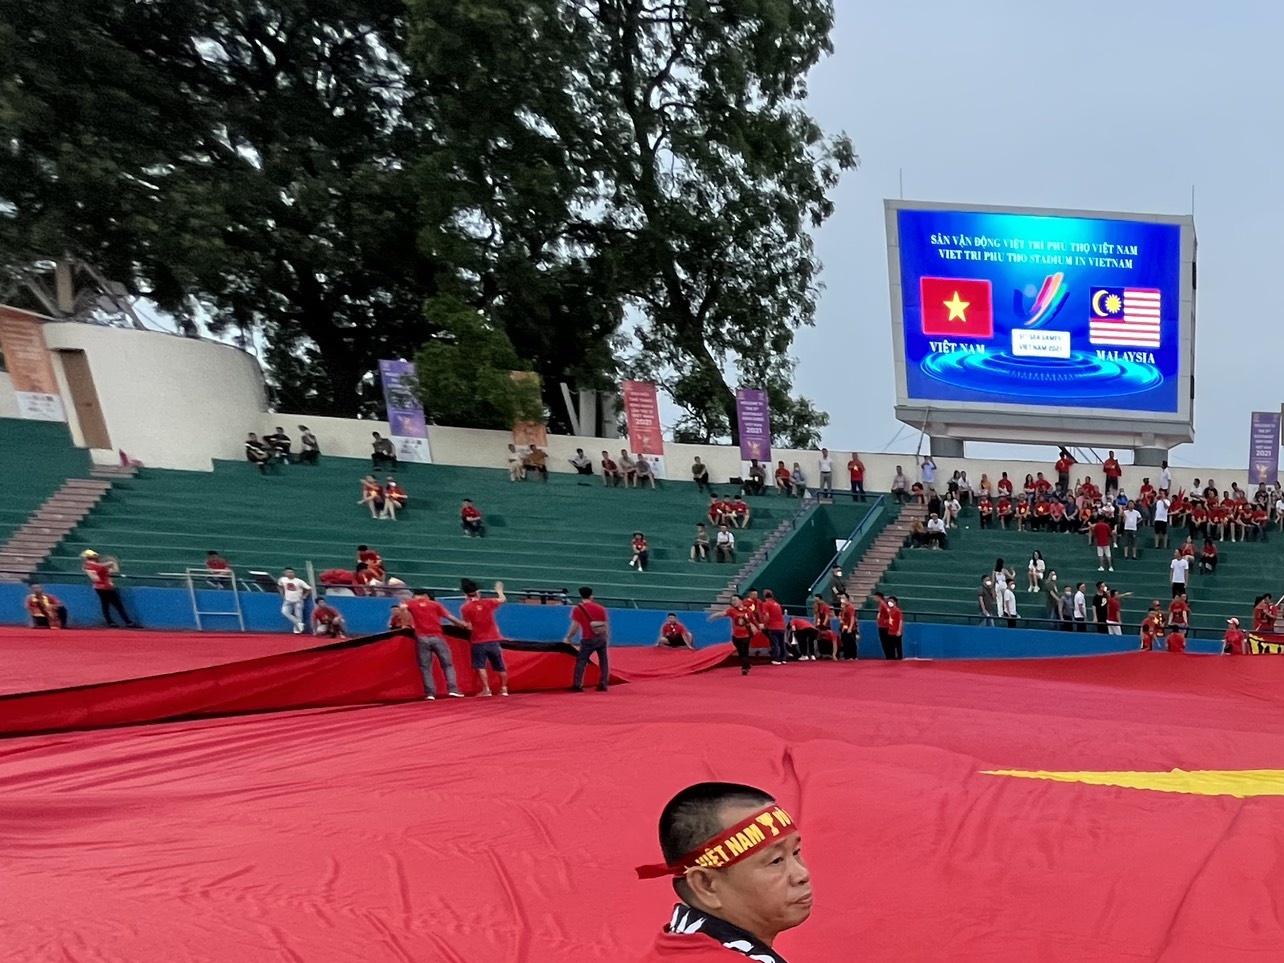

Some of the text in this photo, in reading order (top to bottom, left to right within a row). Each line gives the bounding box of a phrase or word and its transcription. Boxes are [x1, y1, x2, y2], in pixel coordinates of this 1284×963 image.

[931, 233, 950, 245] SÂN
[1092, 242, 1114, 255] VIỆT
[1116, 245, 1138, 255] NAM
[938, 249, 1133, 269] VIET TRI PHU THO STADIUM IN VIETNAM
[959, 343, 985, 355] NAM
[1096, 349, 1155, 364] MALAYSIA
[724, 823, 766, 857] NAM
